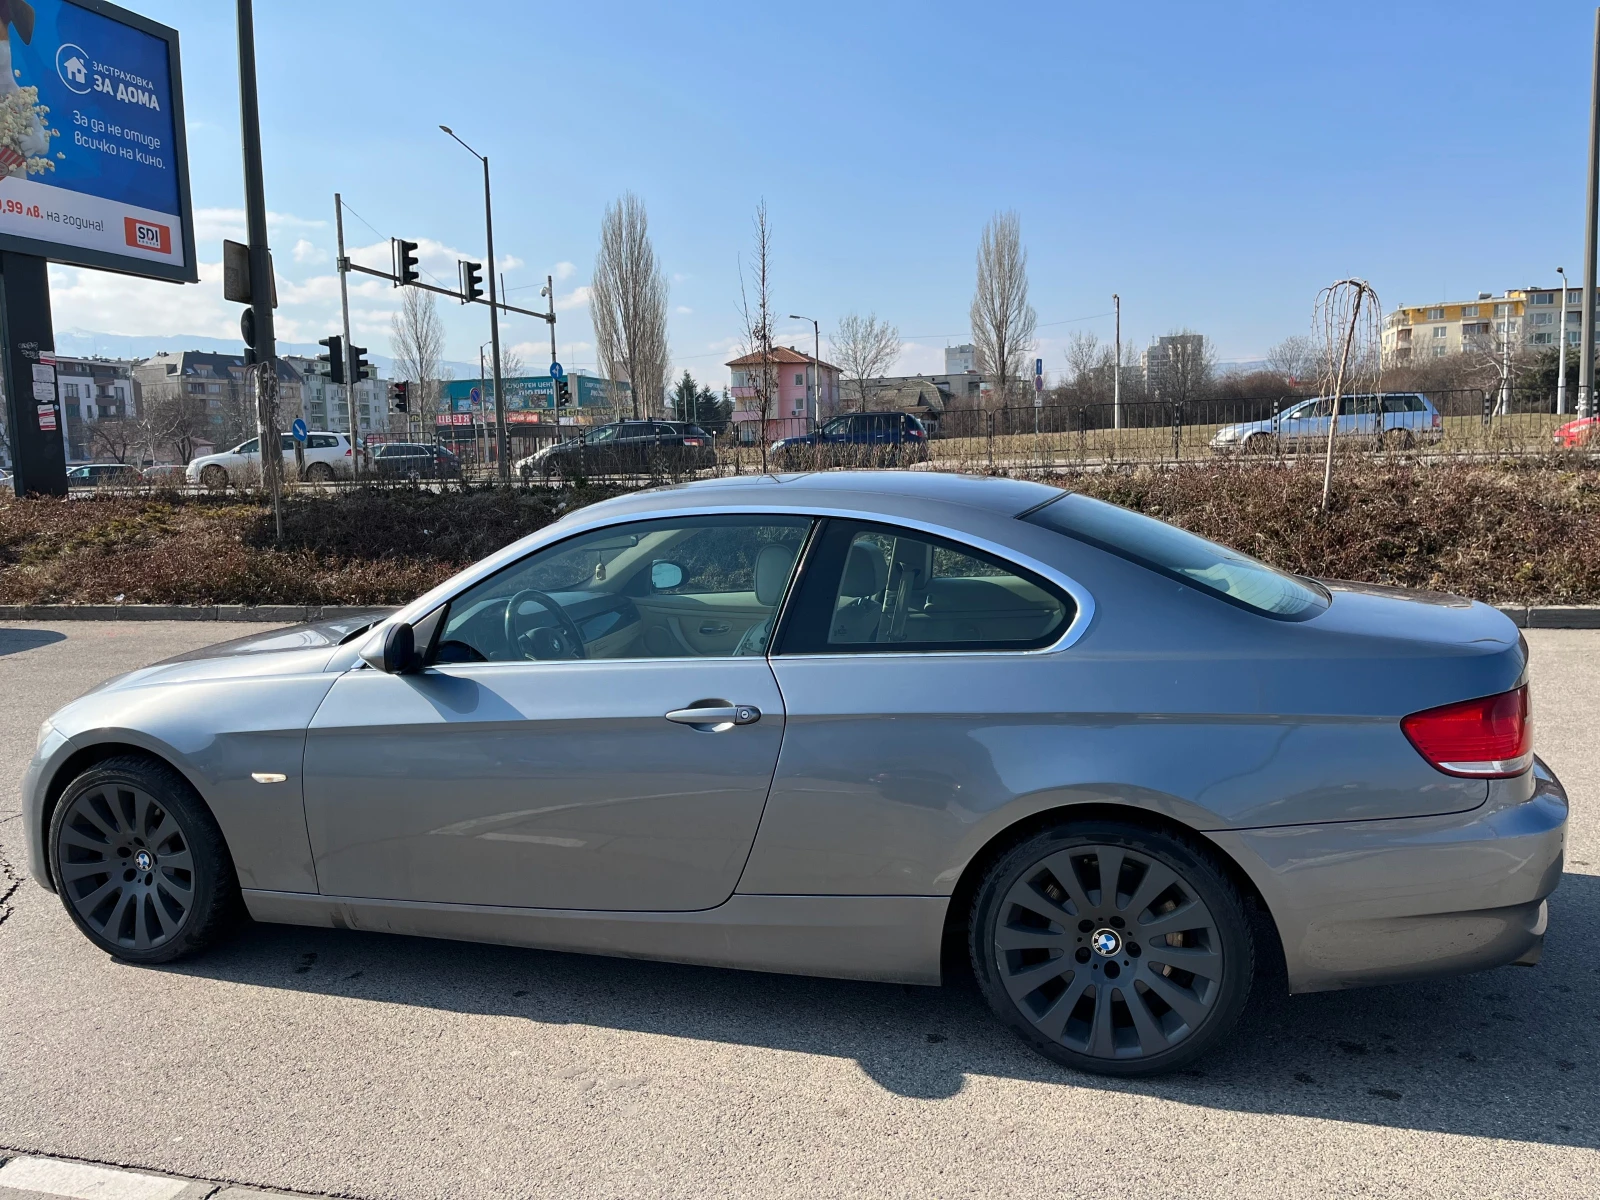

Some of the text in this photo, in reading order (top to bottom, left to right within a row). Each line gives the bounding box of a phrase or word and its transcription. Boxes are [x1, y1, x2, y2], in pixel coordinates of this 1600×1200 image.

[92, 61, 154, 90] ЗАСТРАХОВКА
[93, 74, 160, 111] ЗА ДОМА
[73, 110, 161, 150] За да не отиде
[74, 131, 166, 170] всичко на кино.
[26, 205, 44, 219] лв.
[46, 211, 60, 222] на
[63, 214, 104, 232] година!
[138, 226, 159, 243] SDI
[438, 414, 470, 423] ЦВЕТЯ
